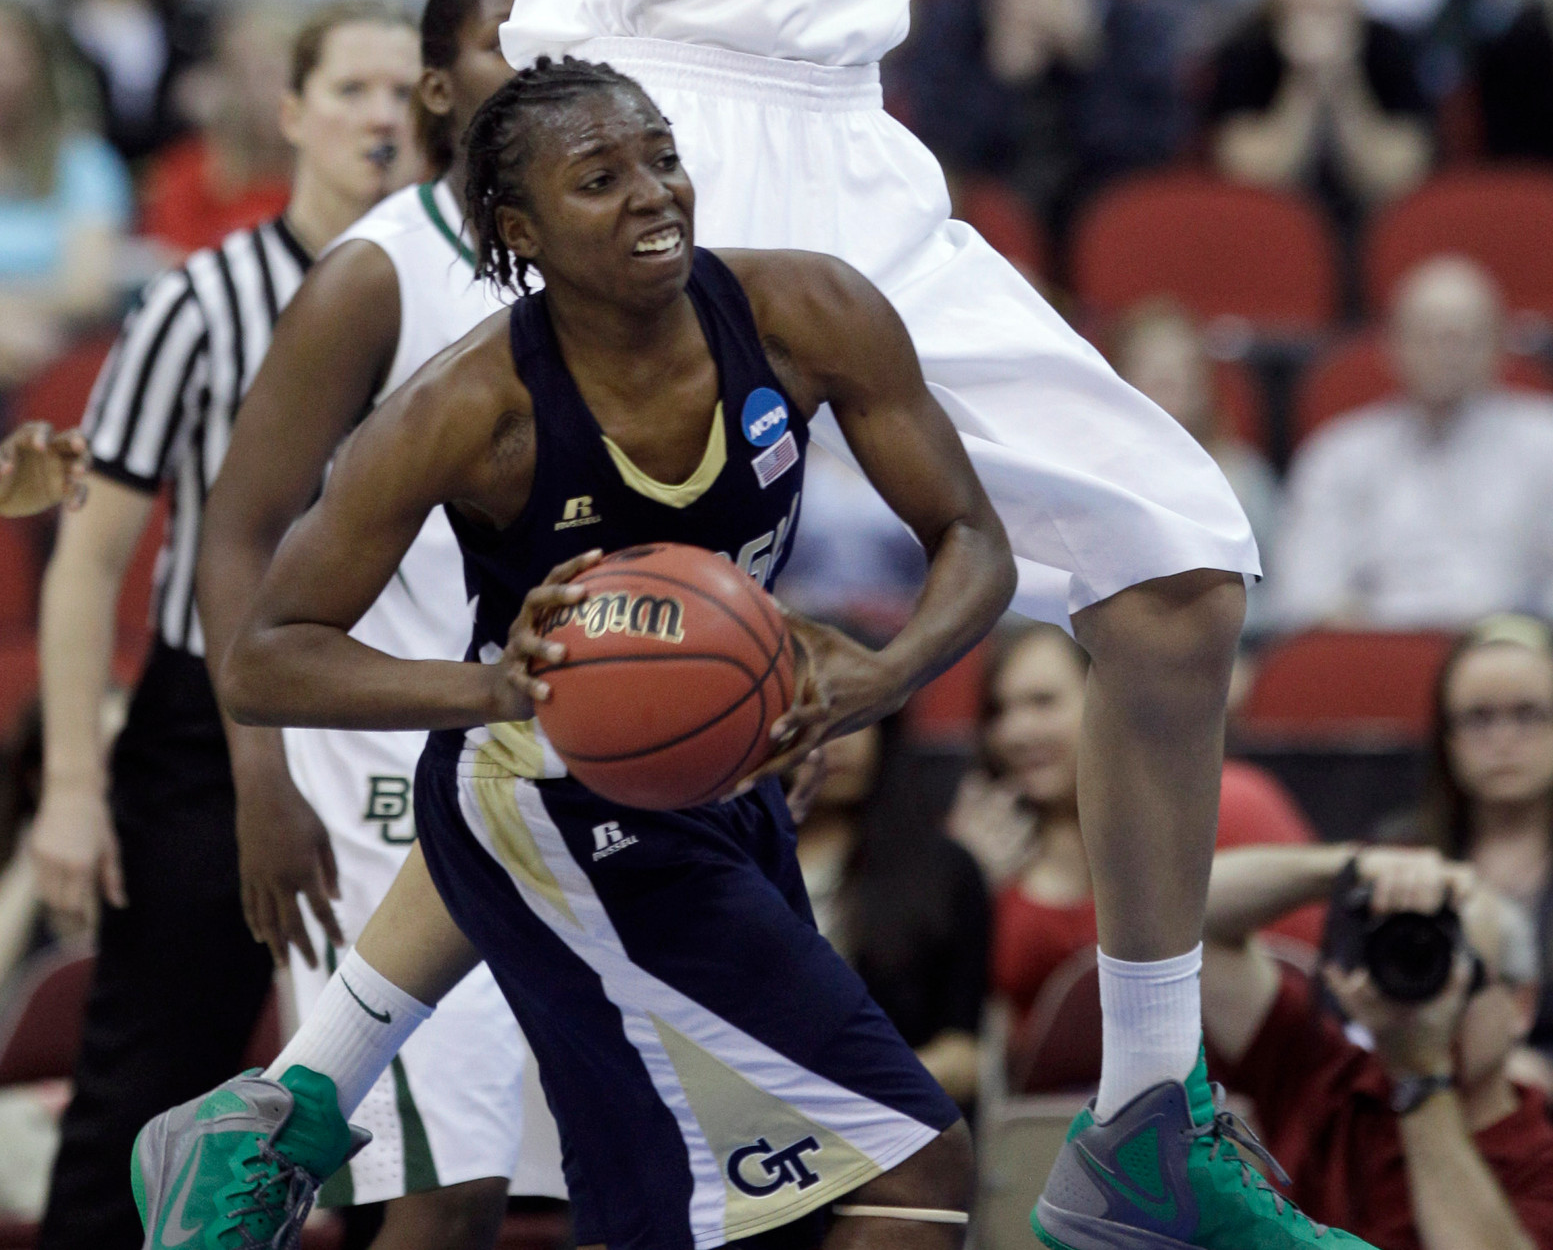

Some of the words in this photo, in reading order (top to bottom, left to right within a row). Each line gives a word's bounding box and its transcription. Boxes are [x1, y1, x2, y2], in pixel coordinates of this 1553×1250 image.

[749, 405, 788, 440] NCAA
[592, 835, 639, 862] RUSSELL
[726, 1135, 822, 1199] GT
